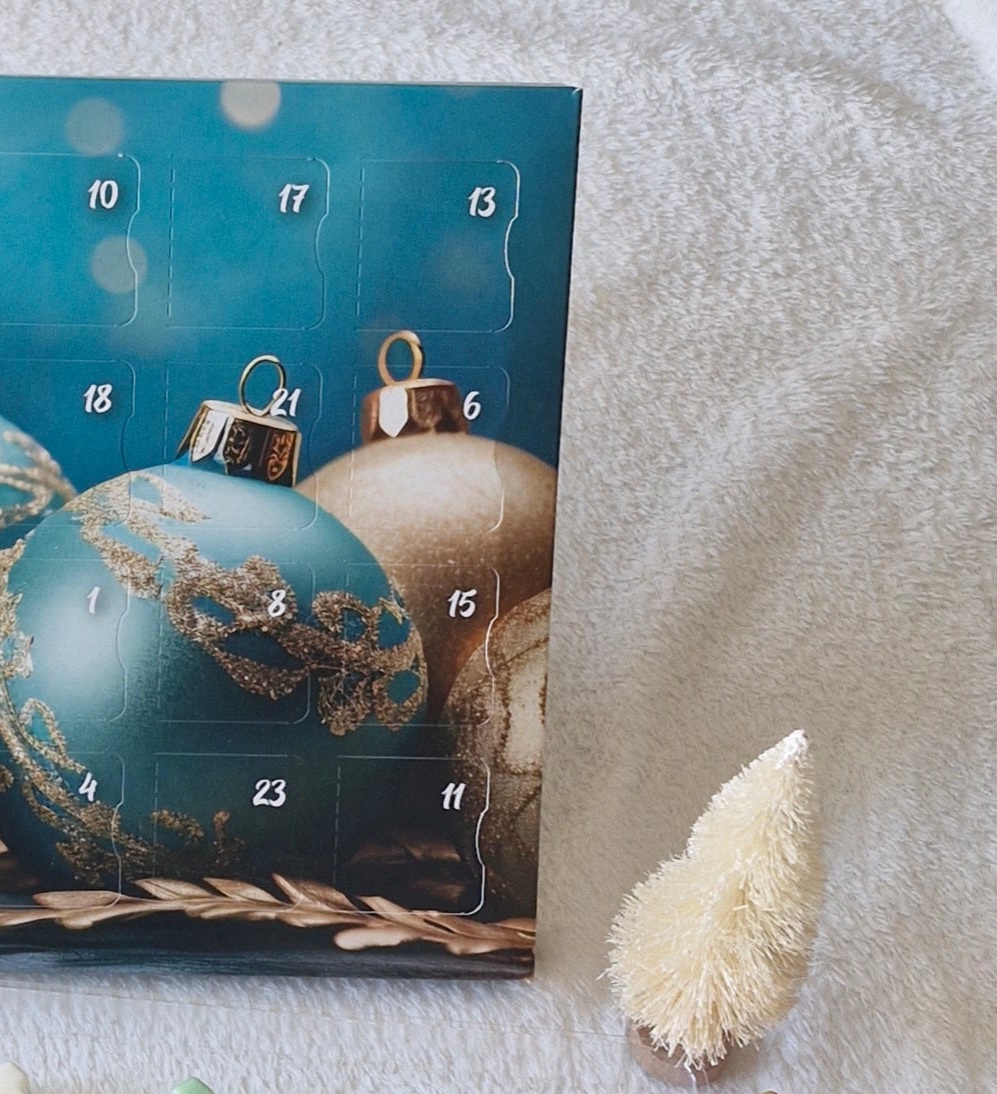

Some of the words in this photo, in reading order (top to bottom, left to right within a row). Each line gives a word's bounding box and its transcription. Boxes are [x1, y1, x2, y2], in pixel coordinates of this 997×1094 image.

[88, 179, 118, 209] 10
[278, 183, 308, 213] 17
[468, 187, 496, 218] 13
[83, 384, 113, 414] 18
[271, 388, 298, 417] 21
[463, 391, 481, 420] 6
[87, 587, 99, 614] 1
[268, 590, 286, 617] 8
[448, 590, 476, 618] 15
[78, 774, 97, 801] 4
[252, 779, 286, 807] 23
[441, 783, 463, 810] 11
